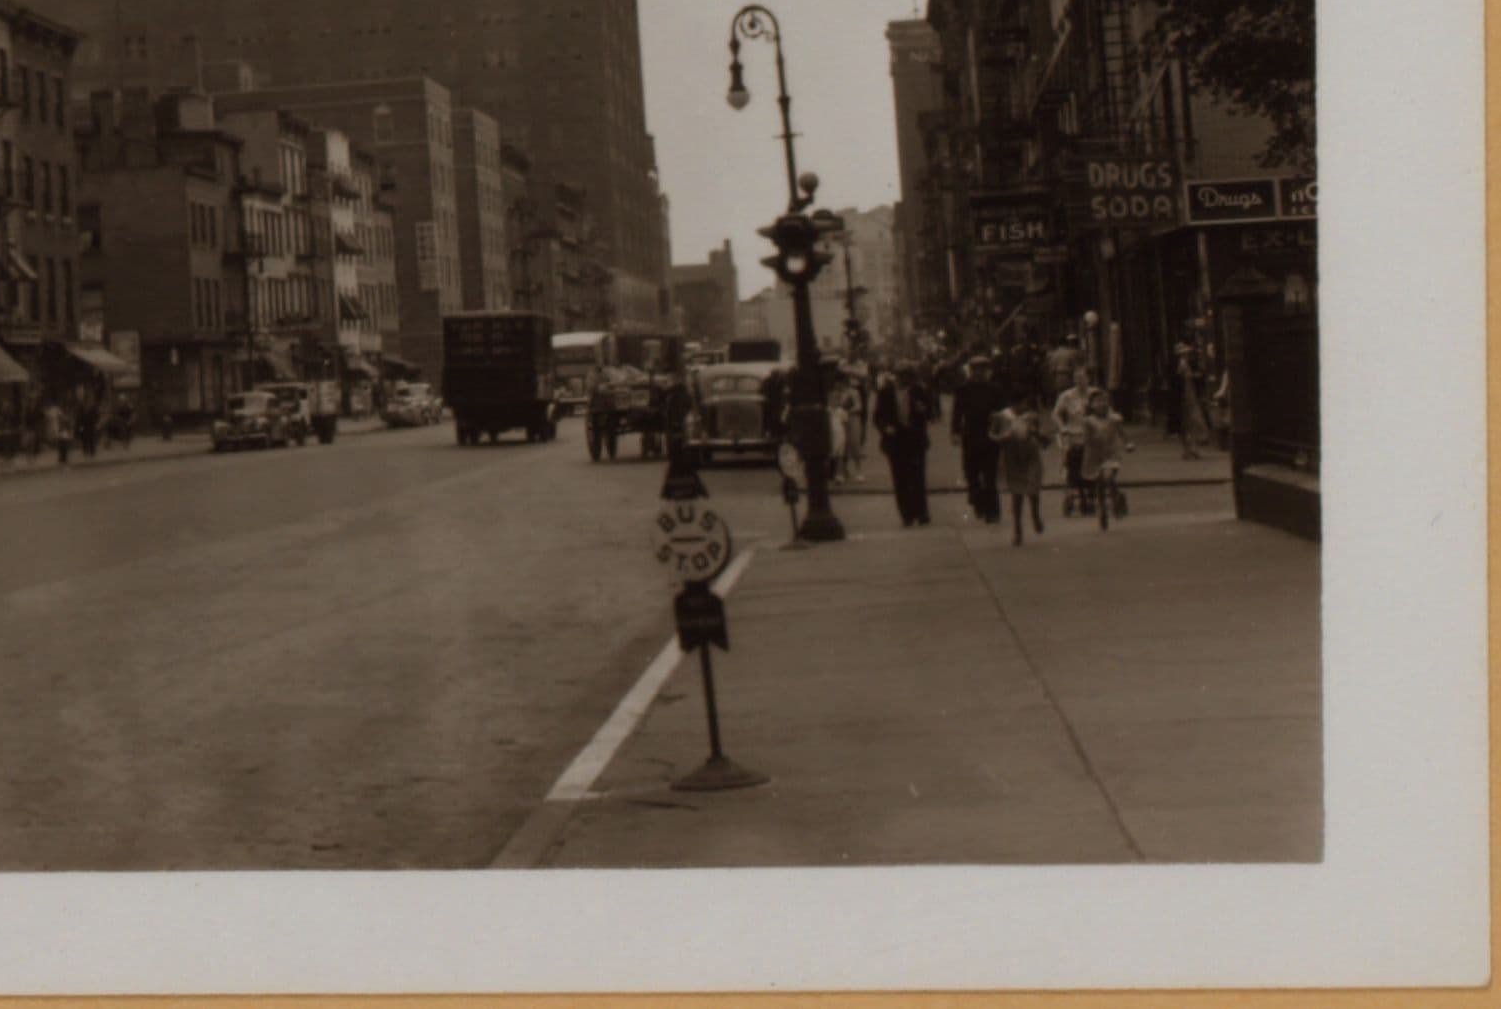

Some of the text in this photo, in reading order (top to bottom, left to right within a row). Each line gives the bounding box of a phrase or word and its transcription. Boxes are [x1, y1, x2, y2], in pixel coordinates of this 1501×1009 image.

[1087, 160, 1173, 189] DRUGS
[1090, 195, 1173, 220] SODA
[1197, 186, 1265, 211] Drugs
[980, 221, 1044, 242] FISH
[656, 503, 720, 536] BUS
[655, 538, 724, 573] STOP
